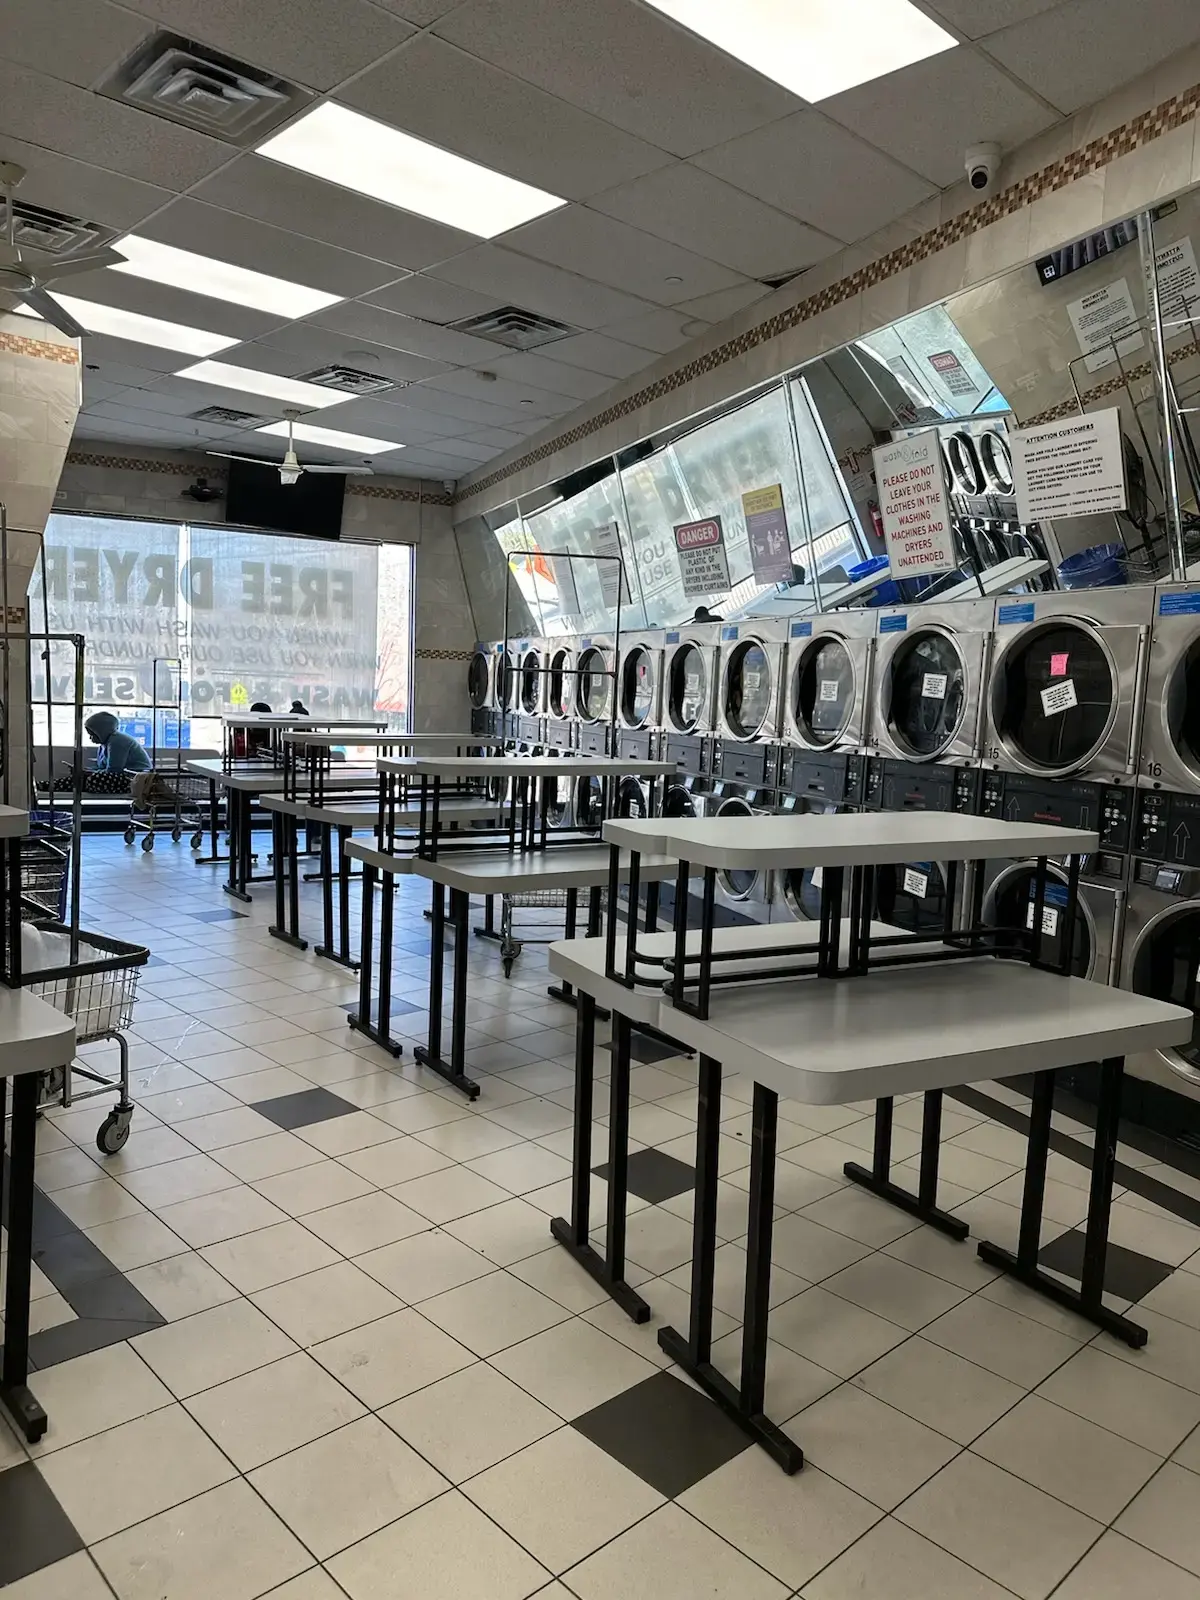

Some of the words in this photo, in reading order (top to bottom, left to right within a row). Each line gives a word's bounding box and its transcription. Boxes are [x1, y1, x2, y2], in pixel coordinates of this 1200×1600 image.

[1026, 432, 1057, 443] ATTENTION
[1058, 423, 1094, 436] CUSTOMERS
[882, 472, 908, 487] PLEASE
[909, 468, 919, 480] DO
[920, 464, 935, 477] NOT
[889, 486, 911, 499] LEAVE
[912, 480, 931, 494] YOUR
[885, 499, 915, 514] CLOTHES
[916, 496, 924, 507] IN
[926, 492, 940, 504] THE
[898, 510, 930, 525] WASHING
[680, 525, 714, 544] DANGER
[890, 525, 926, 540] MACHINES
[927, 521, 943, 533] AND
[904, 538, 932, 552] DRYERS
[680, 551, 695, 559] PLEASE
[687, 556, 706, 566] PLASTIC
[897, 550, 943, 567] UNATTENDED
[684, 584, 703, 593] SHOWER
[703, 580, 728, 590] CURTAINS
[871, 738, 879, 747] 14
[988, 746, 1000, 760] 15
[1148, 763, 1162, 776] 16
